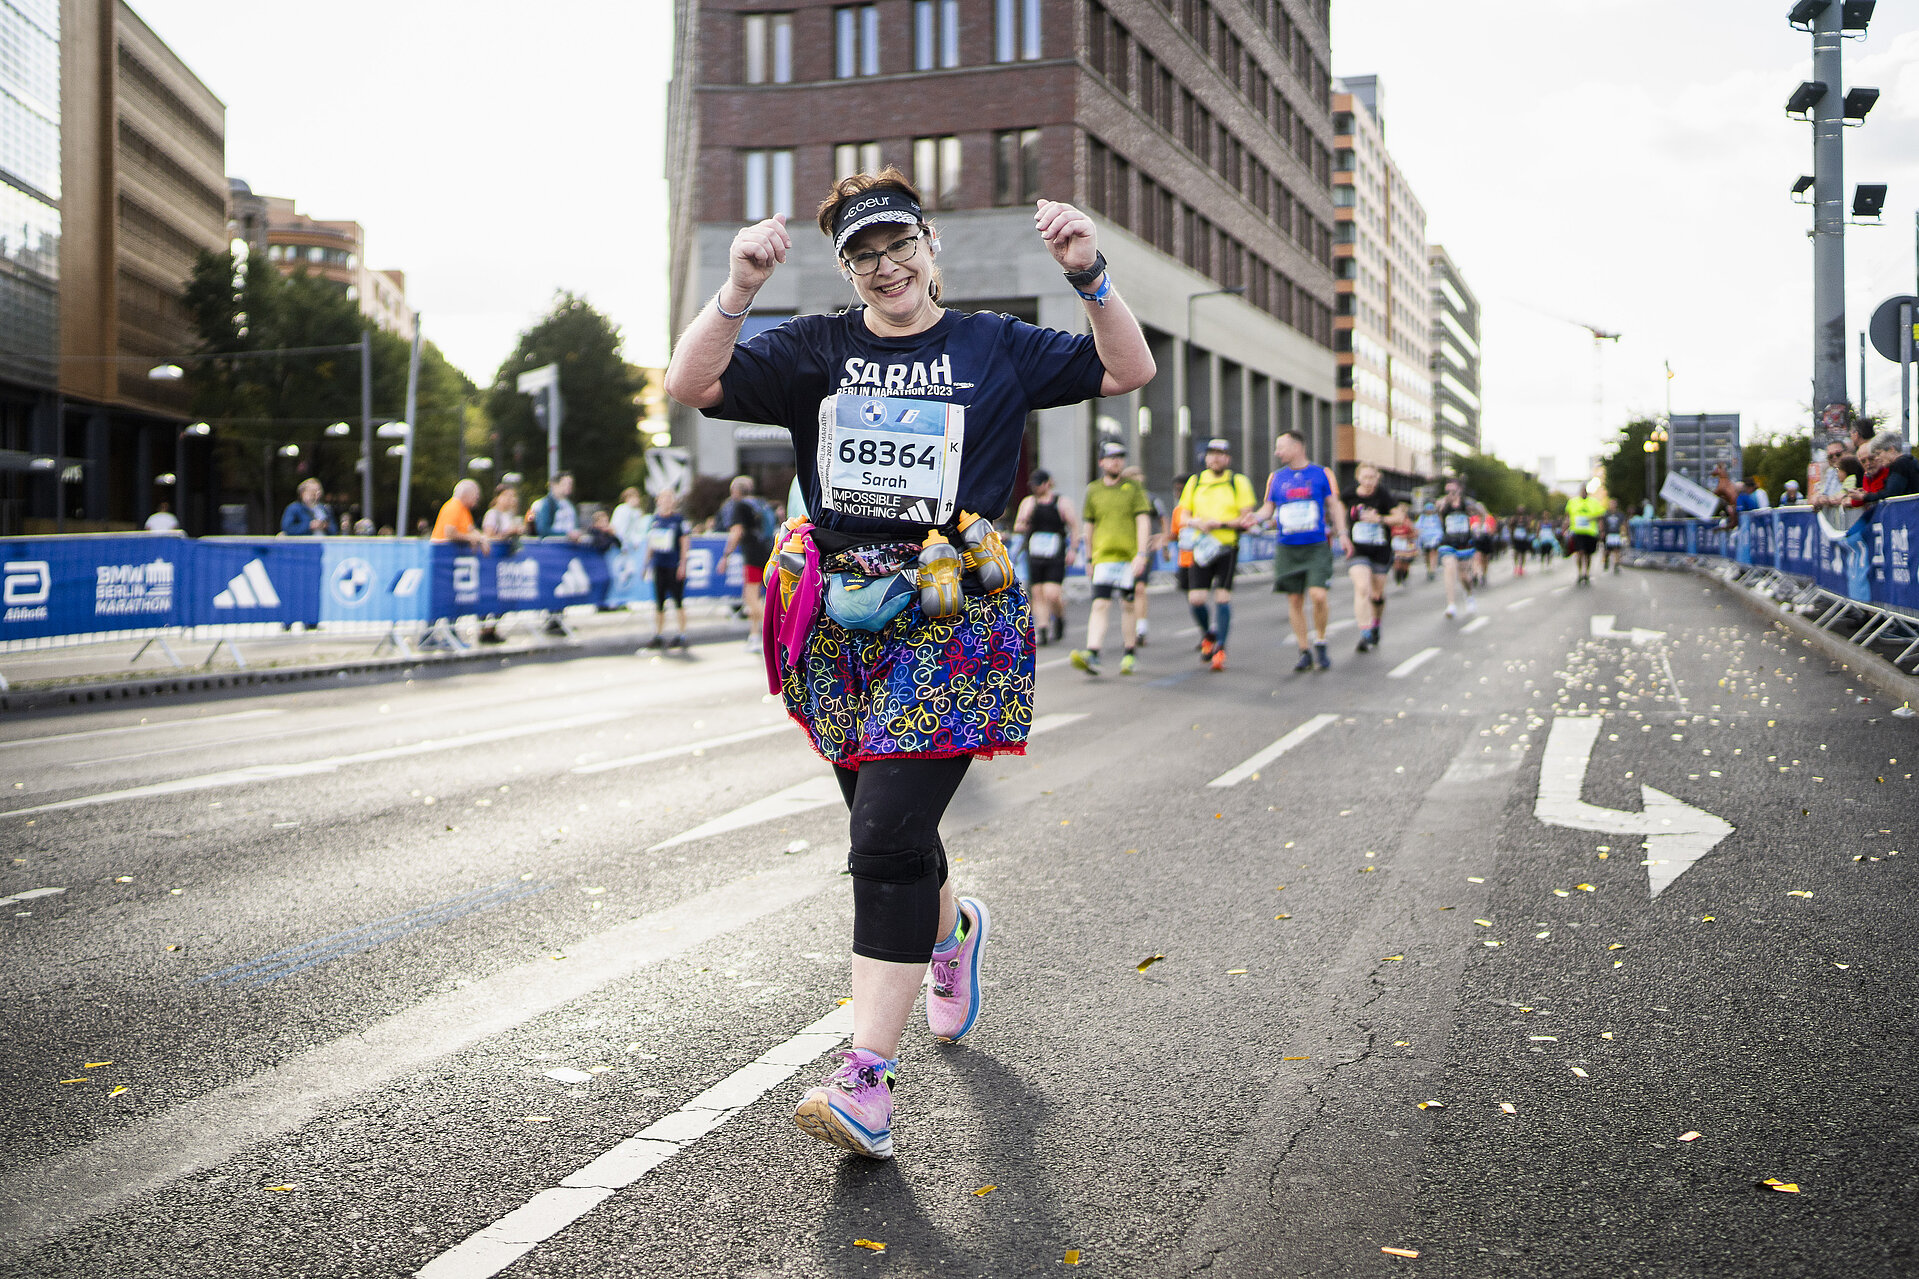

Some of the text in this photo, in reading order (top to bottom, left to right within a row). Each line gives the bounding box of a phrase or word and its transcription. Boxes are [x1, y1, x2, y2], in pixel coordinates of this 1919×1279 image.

[847, 196, 889, 218] coeur
[840, 353, 952, 389] SARAH
[872, 386, 925, 397] MARATHON
[926, 384, 953, 396] 2023
[839, 438, 936, 470] 68364
[950, 442, 959, 453] K
[861, 472, 907, 489] Sarah
[833, 489, 901, 507] IMPOSSIBLE
[844, 503, 897, 519] NOTHING
[96, 564, 145, 585] BMW
[96, 584, 147, 599] BERLIN
[95, 597, 173, 616] MARATHON
